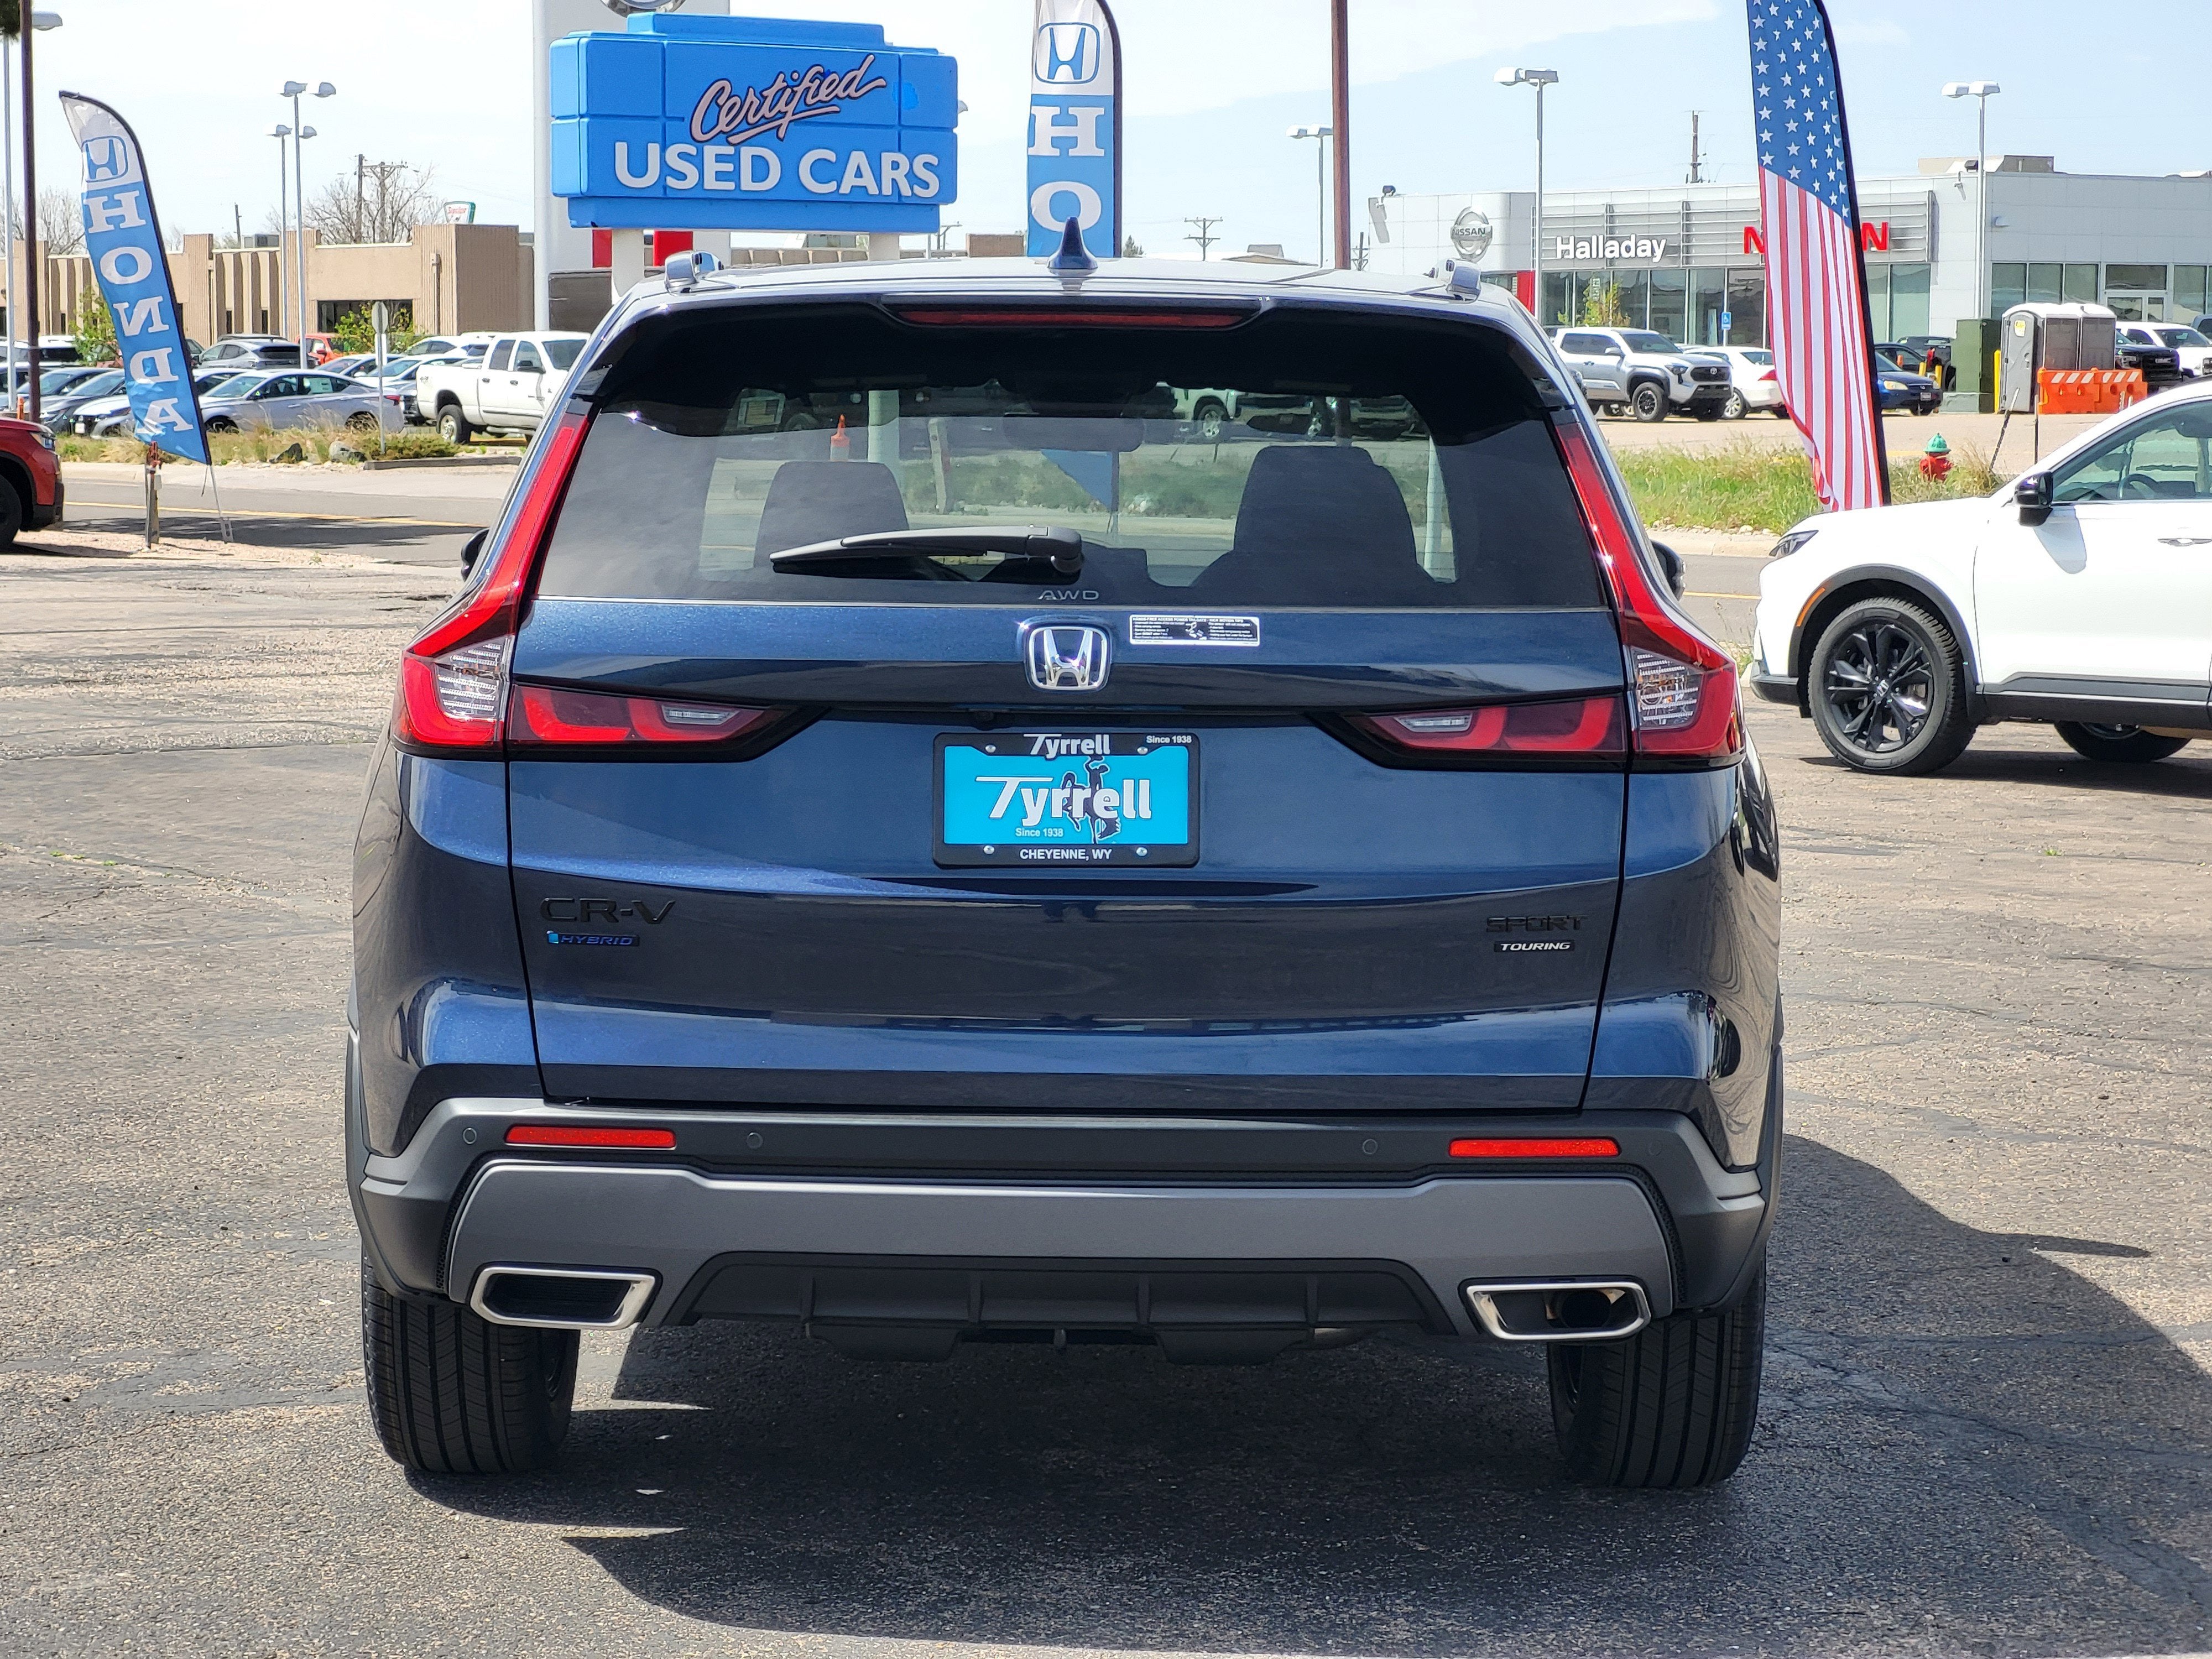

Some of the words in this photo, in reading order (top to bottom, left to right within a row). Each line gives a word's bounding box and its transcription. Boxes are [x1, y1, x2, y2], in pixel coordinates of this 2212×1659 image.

[690, 53, 886, 145] Certified
[614, 141, 781, 192] USED
[798, 148, 940, 198] CARS
[1556, 234, 1667, 263] Halladay
[1037, 589, 1100, 601] AWD
[1023, 733, 1110, 759] Tyrrell
[1146, 735, 1170, 744] Since
[1172, 735, 1192, 744] 1938
[975, 776, 1152, 826] Tyrrell
[1015, 827, 1041, 837] Since
[1043, 828, 1063, 837] 1938
[1020, 848, 1089, 861] CHEYENNE,
[1092, 848, 1113, 859] WY
[540, 897, 676, 924] CR-V
[1486, 915, 1588, 933] SPORT
[561, 935, 634, 946] HYBRID
[1500, 942, 1572, 951] TOURING
